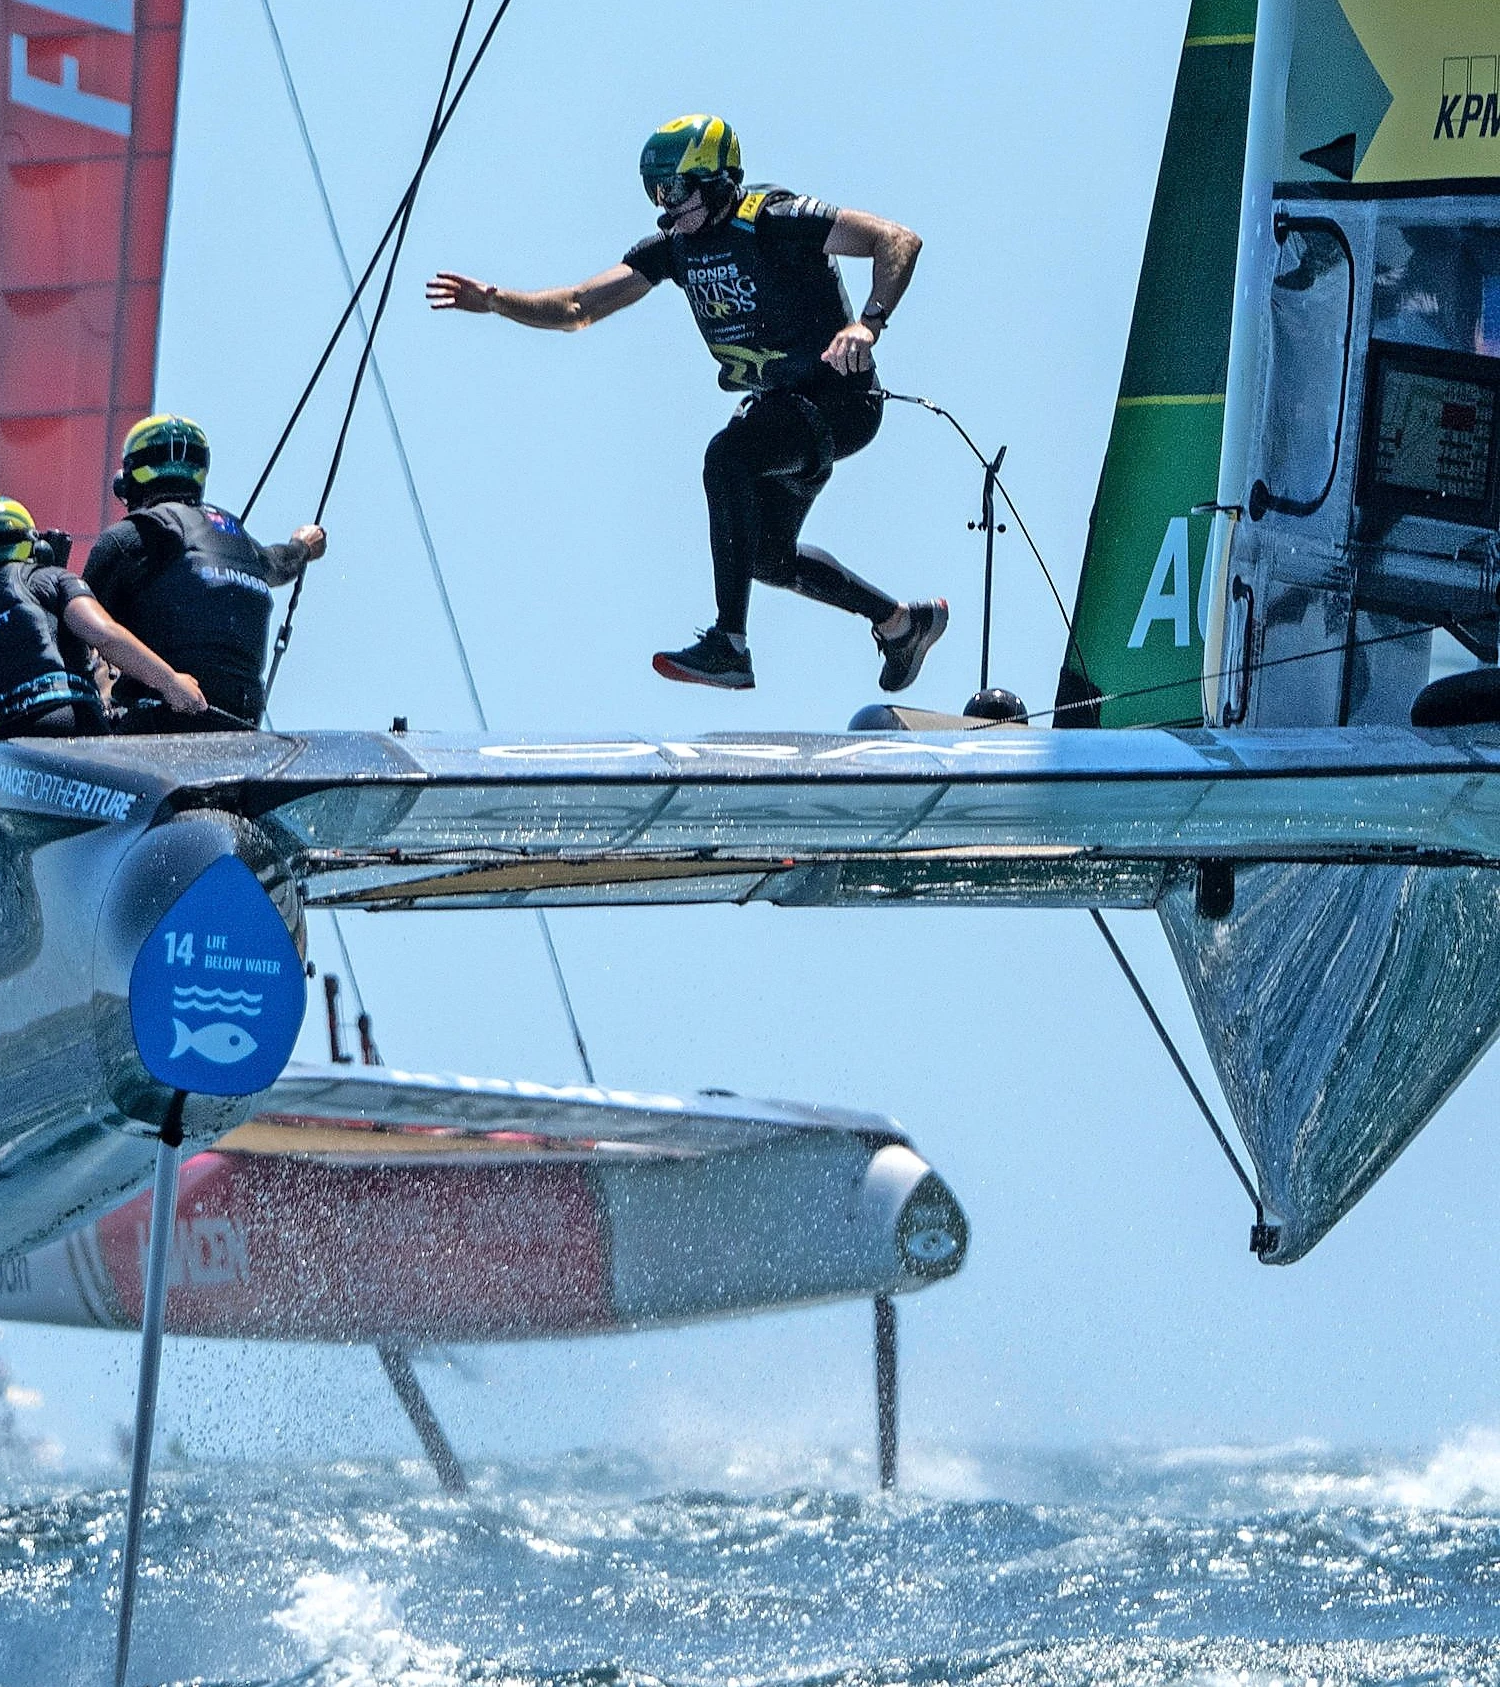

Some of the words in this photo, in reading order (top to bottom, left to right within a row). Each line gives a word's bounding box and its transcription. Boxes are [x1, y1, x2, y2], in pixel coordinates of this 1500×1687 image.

[687, 263, 739, 284] BONDS
[164, 931, 196, 967] 14
[205, 934, 228, 951] LIFE
[204, 954, 243, 972] BELOW
[245, 957, 281, 976] WATER
